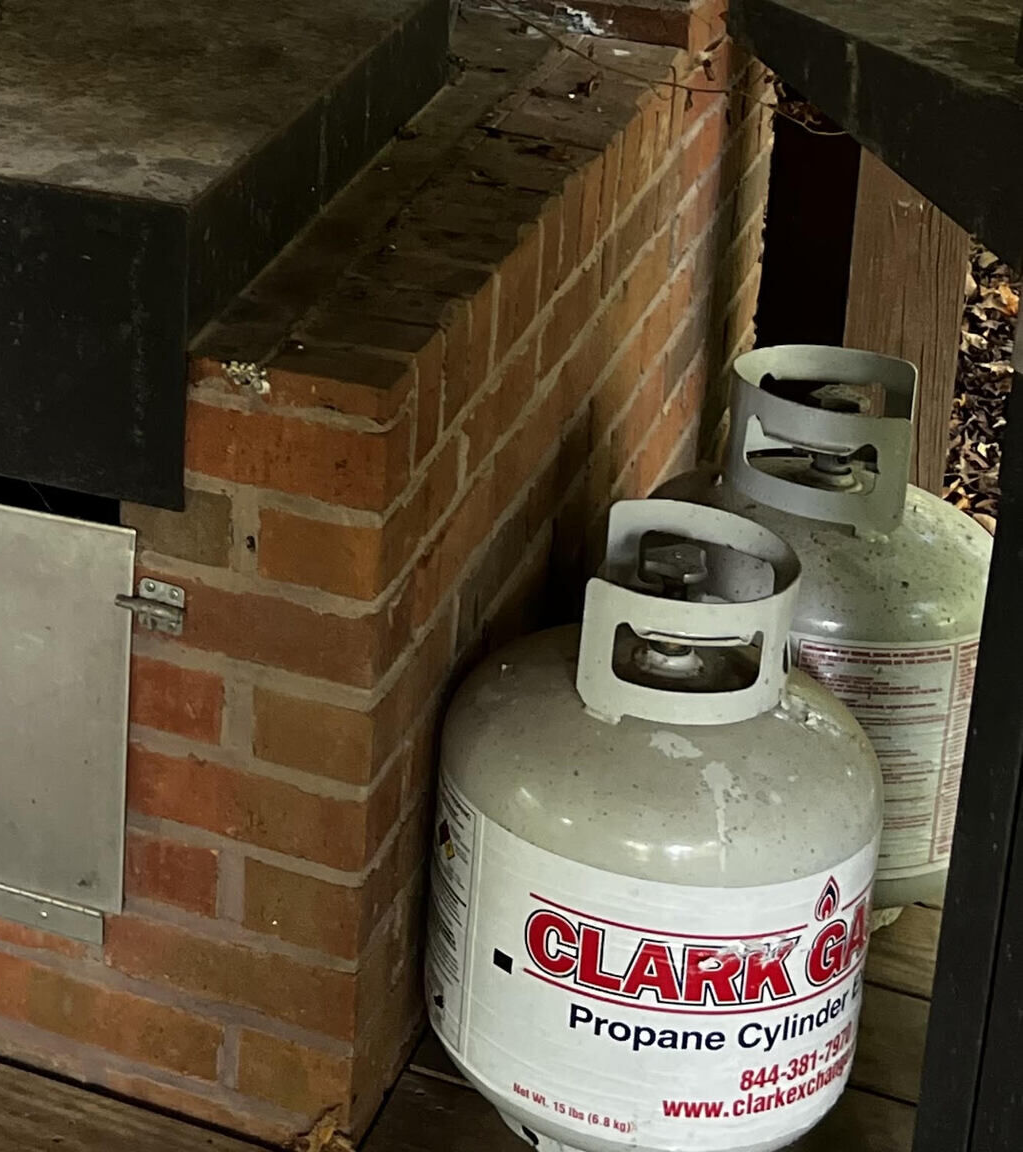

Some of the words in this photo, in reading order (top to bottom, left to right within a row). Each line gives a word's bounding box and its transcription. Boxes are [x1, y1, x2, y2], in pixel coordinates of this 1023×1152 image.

[525, 909, 800, 1006] CLARK
[568, 1003, 726, 1052] Propane
[737, 989, 849, 1052] Cylinder
[513, 1082, 529, 1098] Net
[532, 1091, 549, 1107] Wt.
[553, 1101, 566, 1114] 15
[568, 1106, 584, 1120] lbs
[587, 1112, 610, 1127] (6.8
